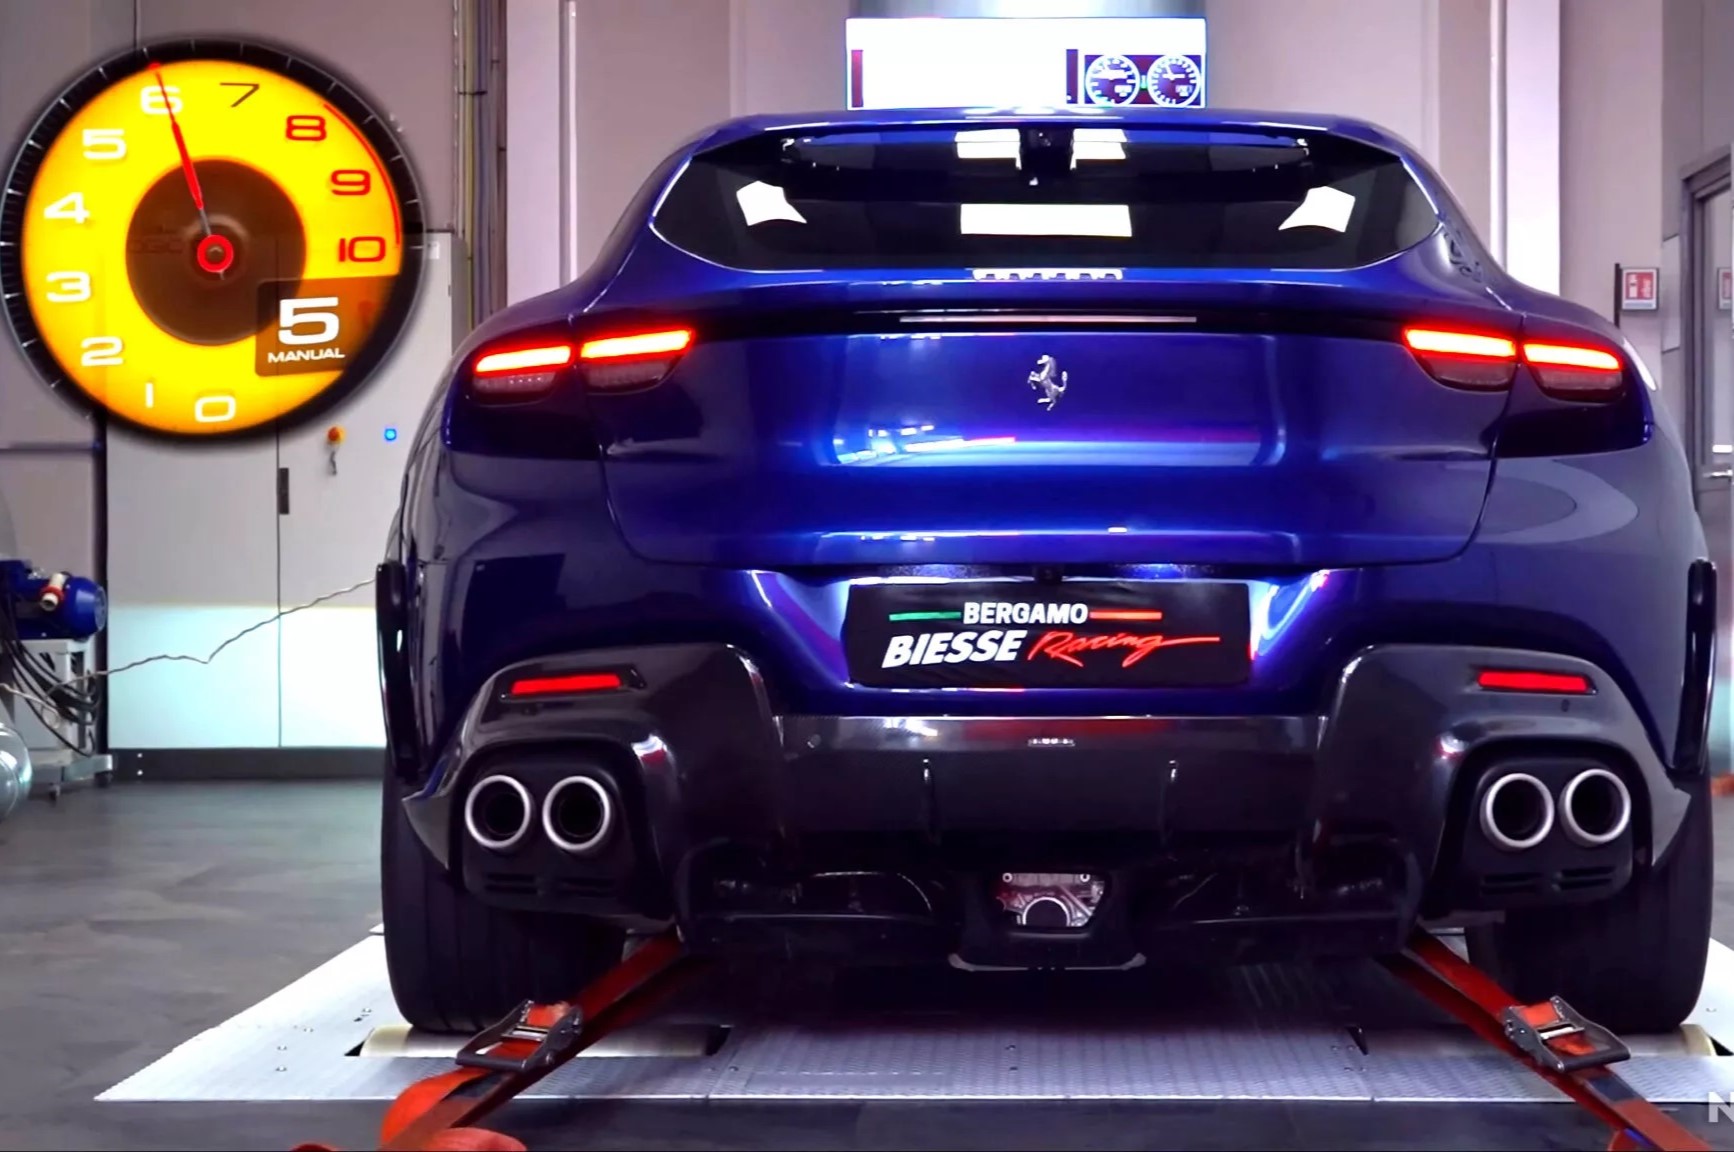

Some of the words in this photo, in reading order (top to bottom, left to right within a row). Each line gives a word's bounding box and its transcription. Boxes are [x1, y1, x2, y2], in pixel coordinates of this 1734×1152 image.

[963, 602, 1088, 625] BERGAMO
[882, 630, 1027, 668] BIESSE
[1028, 630, 1220, 668] Racing
